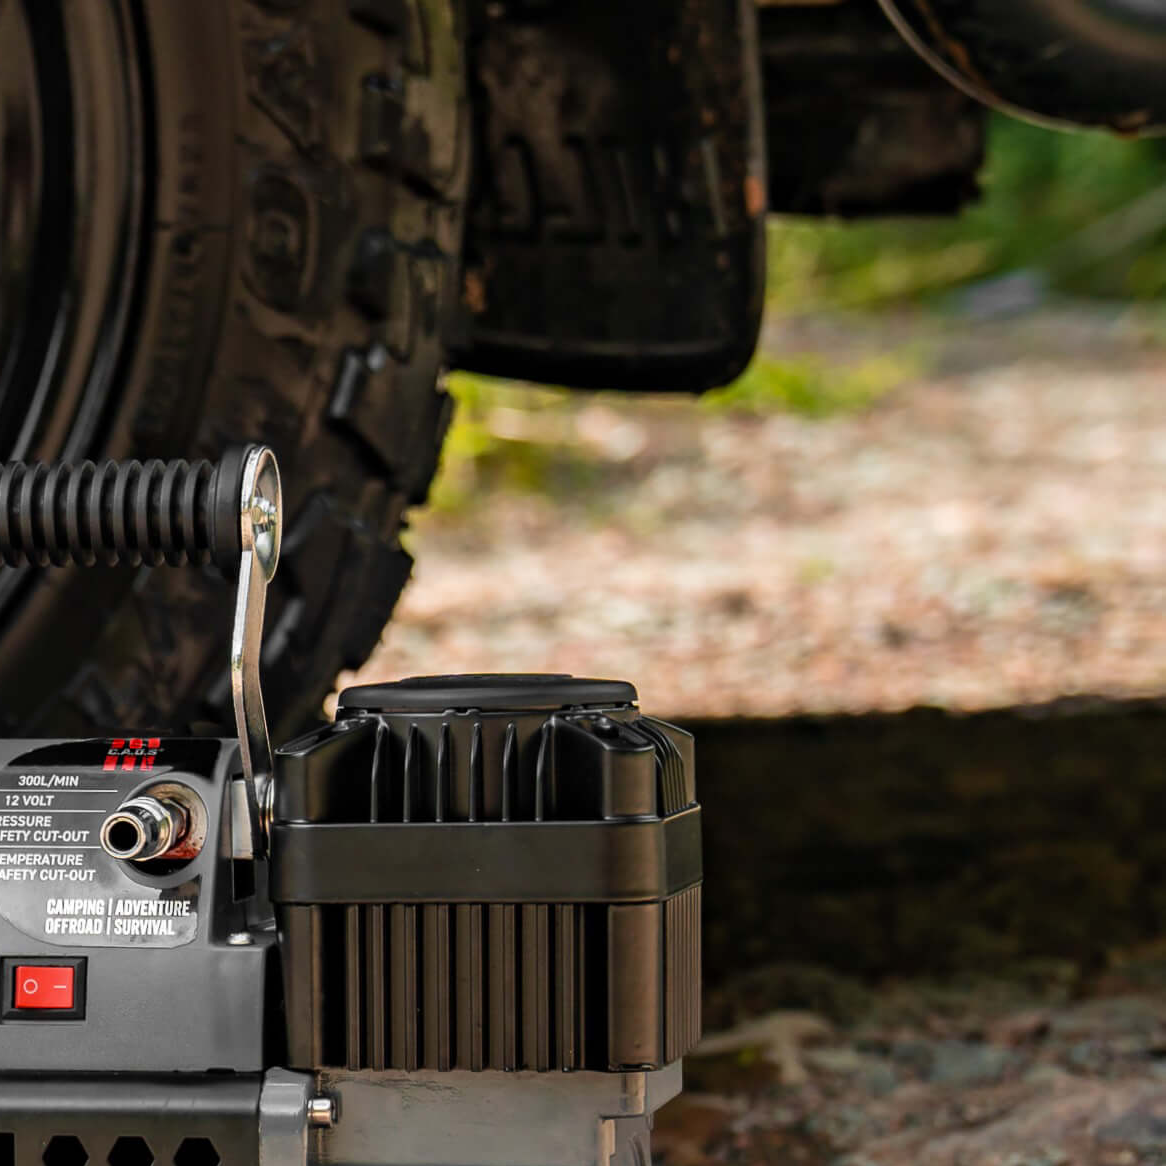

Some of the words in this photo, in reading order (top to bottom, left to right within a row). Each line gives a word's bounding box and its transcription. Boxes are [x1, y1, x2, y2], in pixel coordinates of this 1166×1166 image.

[17, 775, 79, 787] 300L/MIN
[5, 795, 18, 806] 12
[22, 795, 55, 806] VOLT
[33, 830, 90, 842] CUT-OUT
[39, 869, 96, 881] CUT-OUT
[46, 898, 105, 916] CAMPING
[114, 900, 191, 917] ADVENTURE
[44, 918, 103, 935] OFFROAD
[114, 919, 176, 936] SURVIVAL
